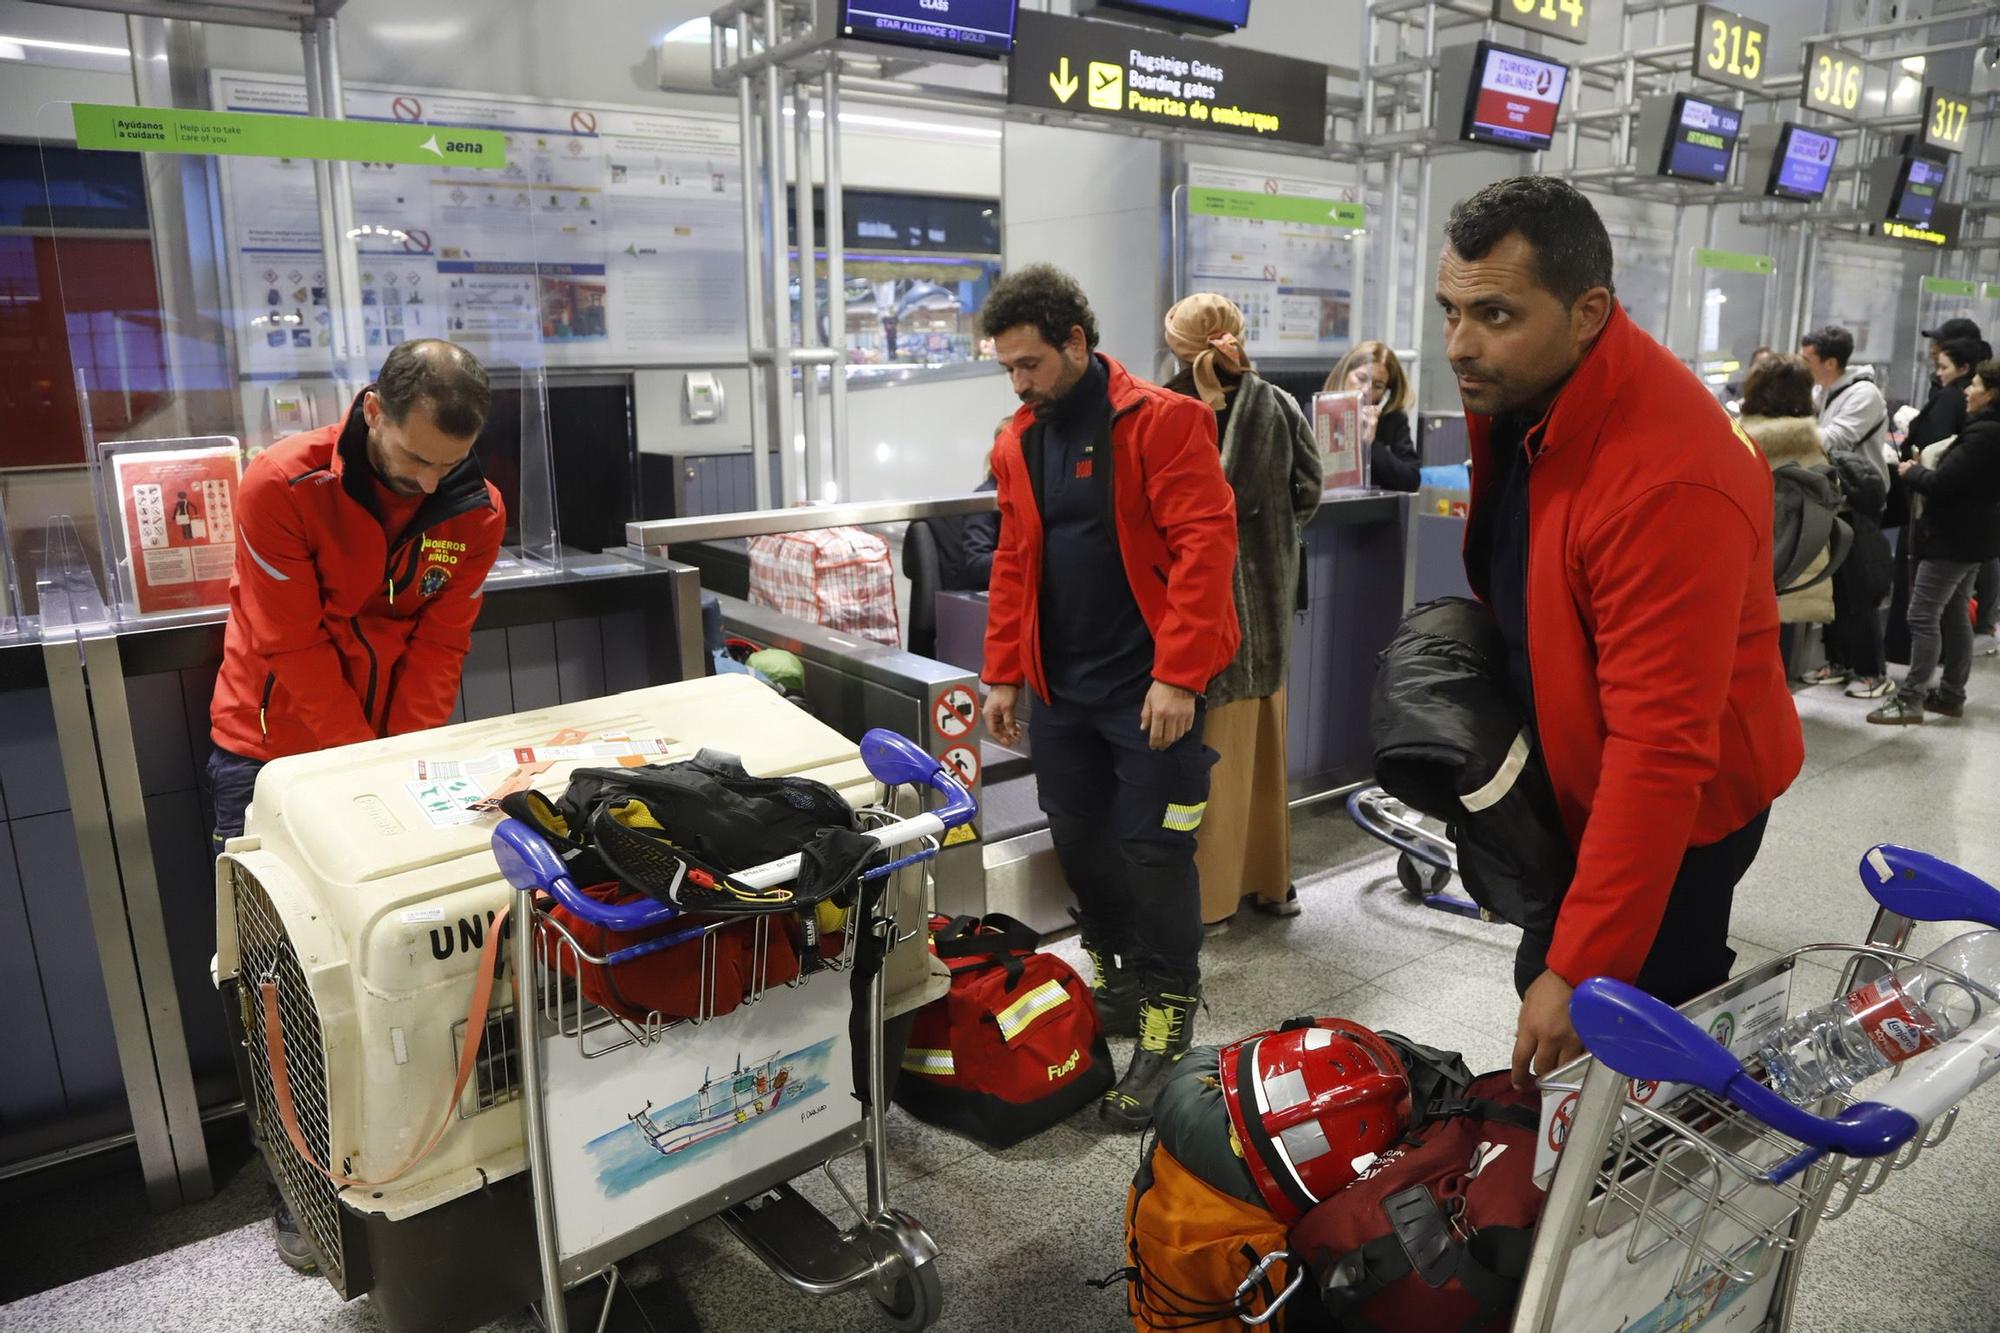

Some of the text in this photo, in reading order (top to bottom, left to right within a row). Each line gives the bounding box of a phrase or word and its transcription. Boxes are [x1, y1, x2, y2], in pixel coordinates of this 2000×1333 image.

[875, 17, 986, 43] STAR ALLIANCE GOLD
[1707, 19, 1762, 80] 315
[1129, 49, 1224, 82] Flugsteige Gates
[1499, 58, 1537, 77] TURKISH
[1129, 69, 1216, 99] Boarding gates
[1495, 72, 1534, 92] AIRLINES
[1814, 55, 1861, 110] 316
[1128, 90, 1280, 133] Puertas de embarque
[1931, 97, 1969, 143] 317
[117, 119, 164, 131] Ayúdanos
[127, 130, 165, 141] cuidarte
[180, 123, 241, 135] Help us to take
[181, 133, 227, 144] care of you
[445, 140, 483, 154] aena
[1047, 1048, 1080, 1081] Fuego
